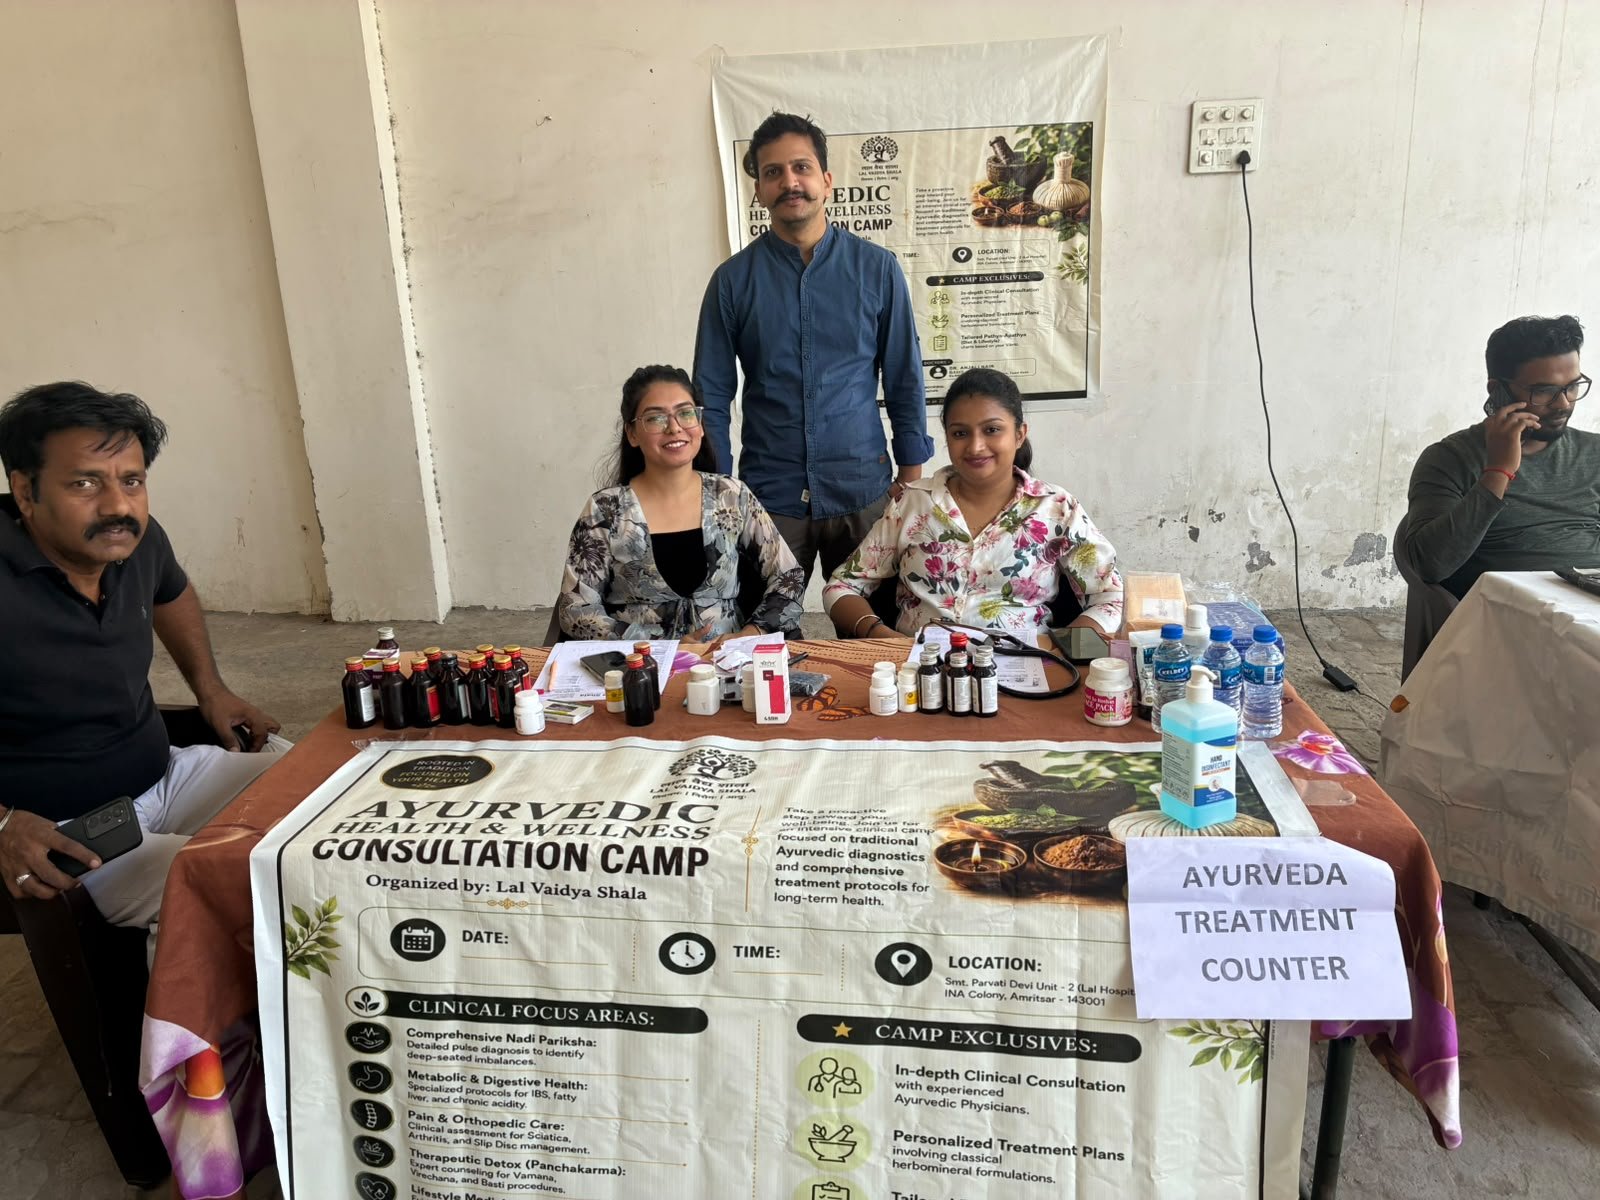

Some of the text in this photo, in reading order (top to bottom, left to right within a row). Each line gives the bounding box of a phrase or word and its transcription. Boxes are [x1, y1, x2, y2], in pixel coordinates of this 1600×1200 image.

[854, 218, 893, 232] CAMP
[979, 274, 1030, 282] EXCLUSIVES:
[1095, 703, 1115, 712] PACK
[650, 786, 672, 794] LAL
[674, 784, 714, 794] VAIDYA
[346, 800, 719, 824] AYURVEDIC
[329, 821, 711, 840] HEALTH & WELLNESS
[777, 833, 918, 846] focused on traditional
[901, 827, 935, 835] camp
[312, 838, 709, 877] CONSULTATION CAMP
[776, 845, 926, 862] Ayurvedic diagnostics
[775, 862, 905, 877] and comprehensive
[1182, 862, 1348, 888] AYURVEDA
[366, 874, 647, 900] Organized by: Lal Vaidya Shala
[774, 877, 930, 895] treatment protocols for
[774, 892, 885, 906] long-term health.
[1175, 908, 1357, 934] TREATMENT
[462, 929, 509, 944] DATE:
[732, 945, 780, 958] TIME:
[948, 956, 1042, 972] LOCATION:
[1201, 956, 1350, 982] COUNTER
[945, 977, 1136, 997] Smt. Parvati Devi Unit 2 (Lal Hospit
[945, 989, 1105, 1006] INA Colony, Amritsar 143001
[408, 1000, 655, 1026] CLINICAL FOCUS AREAS:
[406, 1027, 597, 1047] Comprehensive Nadi Pariksha:
[875, 1024, 1098, 1054] CAMP EXCLUSIVES:
[407, 1040, 585, 1060] Detailed pulse diagnosis to identify
[407, 1051, 537, 1066] deep-seated imbalances.
[407, 1069, 588, 1091] Metabolic & Digestive Health:
[895, 1064, 1126, 1093] In-depth Clinical Consultation
[895, 1080, 1004, 1097] with experienced
[408, 1081, 577, 1103] Specialized protocols for IBS, fatty
[431, 1096, 450, 1104] and
[452, 1096, 489, 1107] chronic
[491, 1099, 527, 1110] acidity.
[894, 1093, 1030, 1115] Ayurvedic Physicians.
[407, 1109, 565, 1131] Pain & Orthopedic Care:
[407, 1121, 571, 1143] Clinical assessment for Sciatica,
[407, 1131, 590, 1155] Arthritis, and Slip Disc management.
[893, 1129, 1125, 1161] Personalized Treatment Plans
[409, 1147, 626, 1176] Therapeutic Detox (Panchakarma):
[892, 1146, 1003, 1164] involving classical
[409, 1158, 557, 1183] Expert counseling for Vamana,
[410, 1167, 566, 1194] Virechana, and Basti procedures.
[892, 1159, 1056, 1184] herbomineral formulations.
